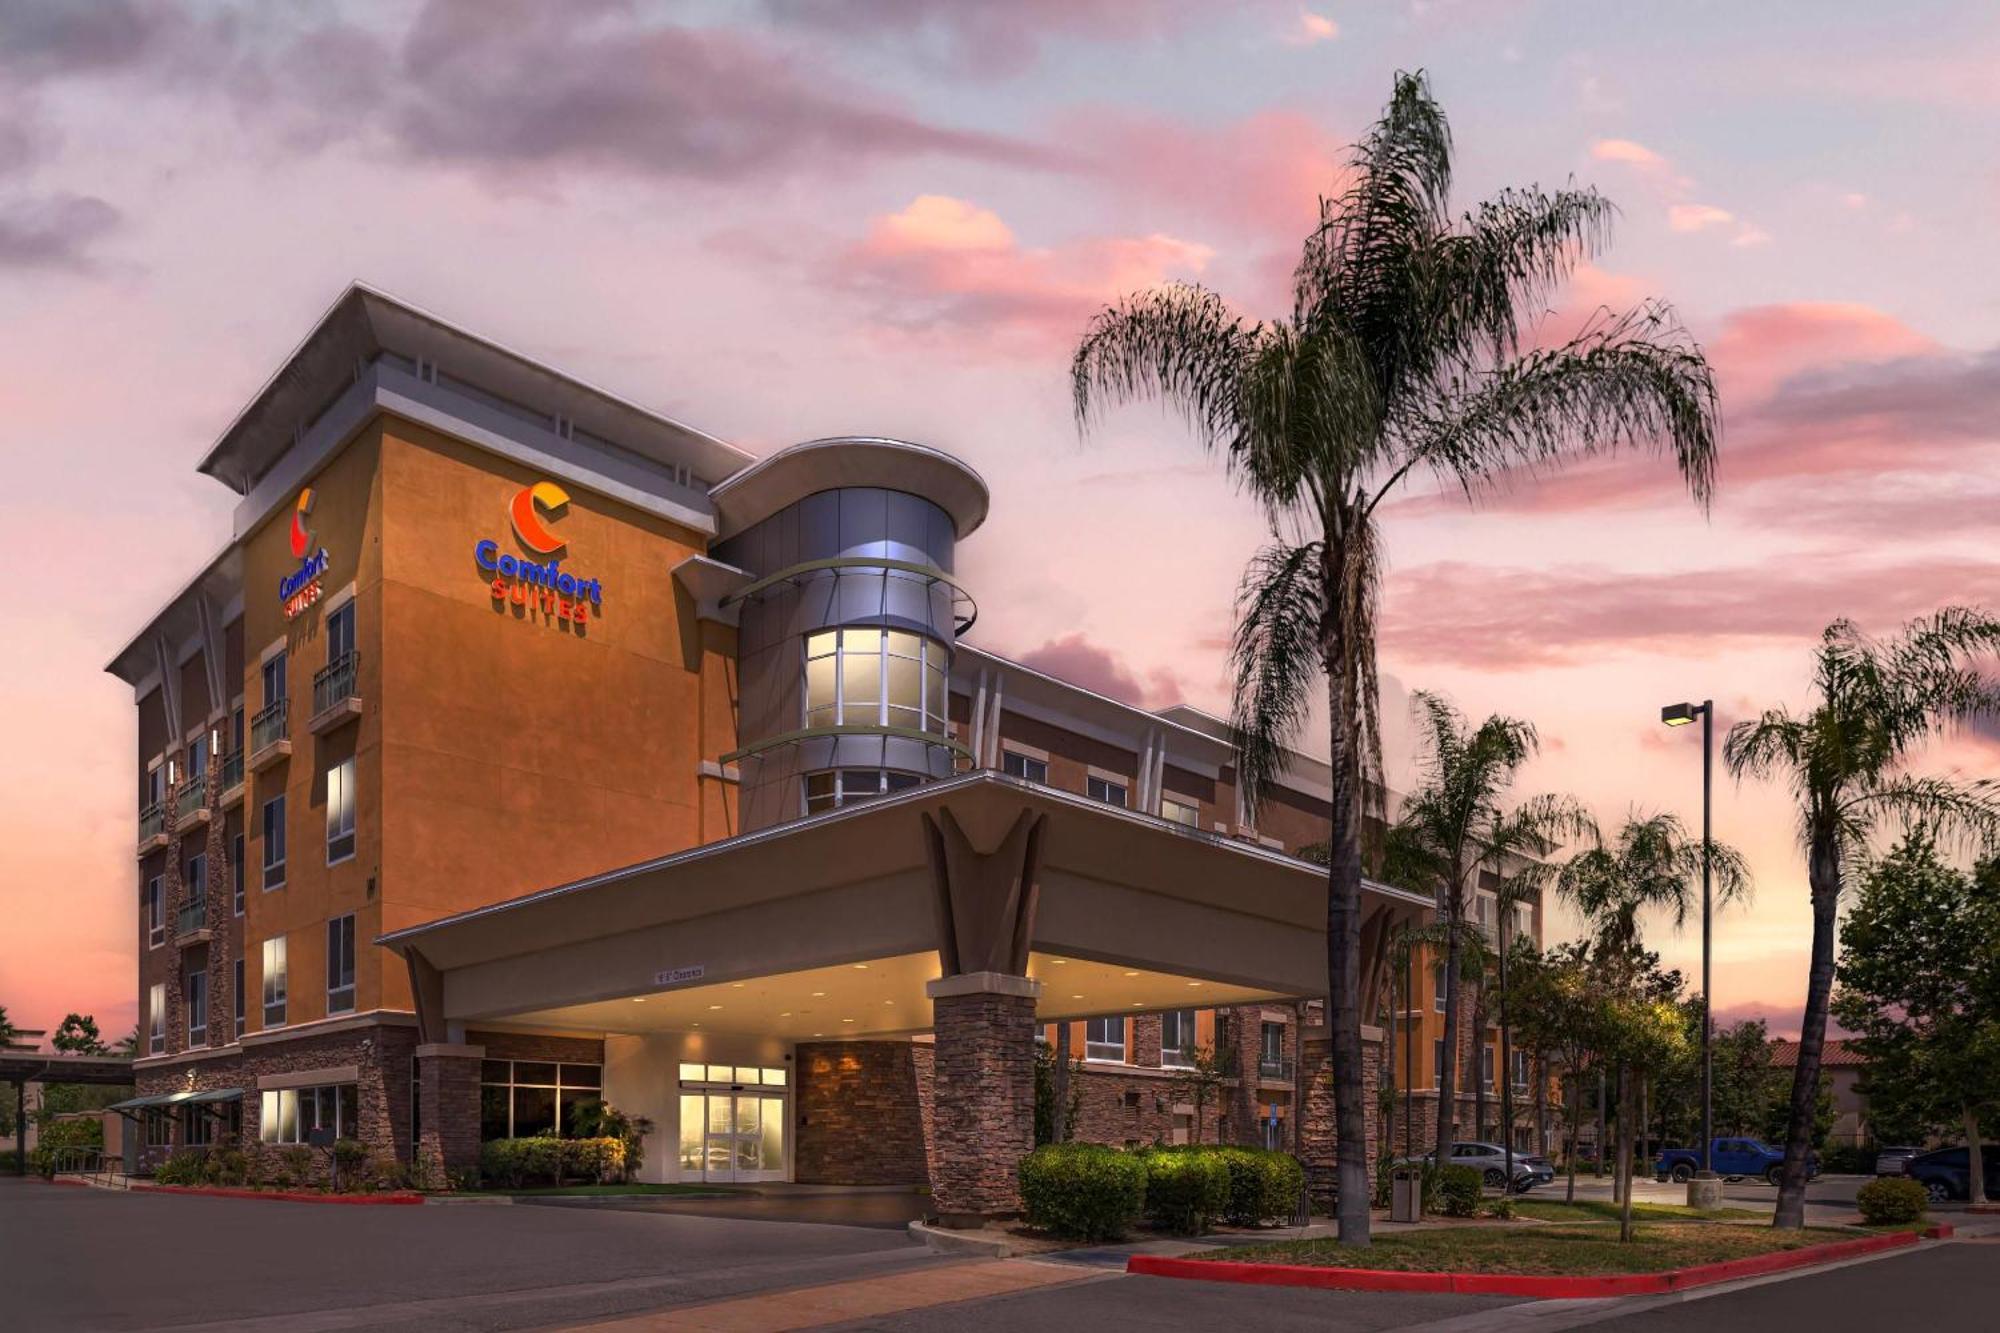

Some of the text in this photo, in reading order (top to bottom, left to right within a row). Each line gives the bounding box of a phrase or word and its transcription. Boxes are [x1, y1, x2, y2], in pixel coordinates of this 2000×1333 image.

[280, 547, 328, 602] Comfort
[476, 540, 602, 604] Comfort
[491, 578, 588, 624] SUITES
